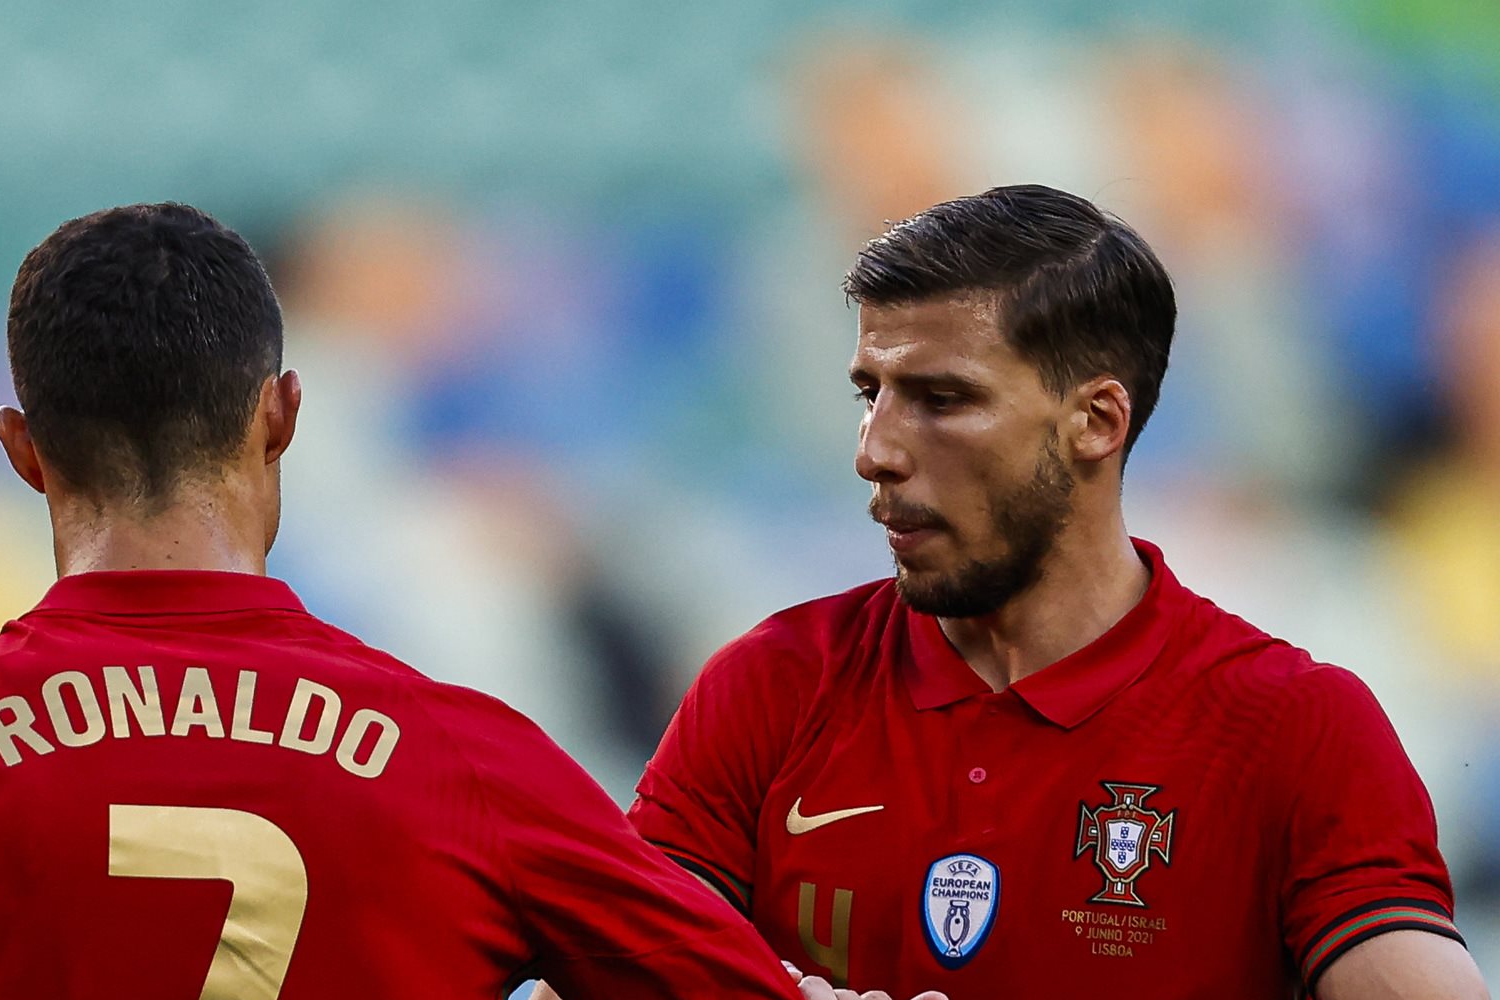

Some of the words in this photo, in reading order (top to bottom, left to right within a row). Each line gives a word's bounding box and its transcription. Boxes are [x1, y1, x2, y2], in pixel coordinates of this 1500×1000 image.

[948, 862, 979, 876] UEFA
[932, 877, 991, 891] EUROPEAN
[931, 888, 990, 901] CHAMPIONS
[798, 882, 853, 990] 4
[1075, 925, 1083, 936] 9
[1086, 927, 1122, 941] JUNHO
[1127, 930, 1153, 944] 2021
[1092, 942, 1133, 957] LISBOA
